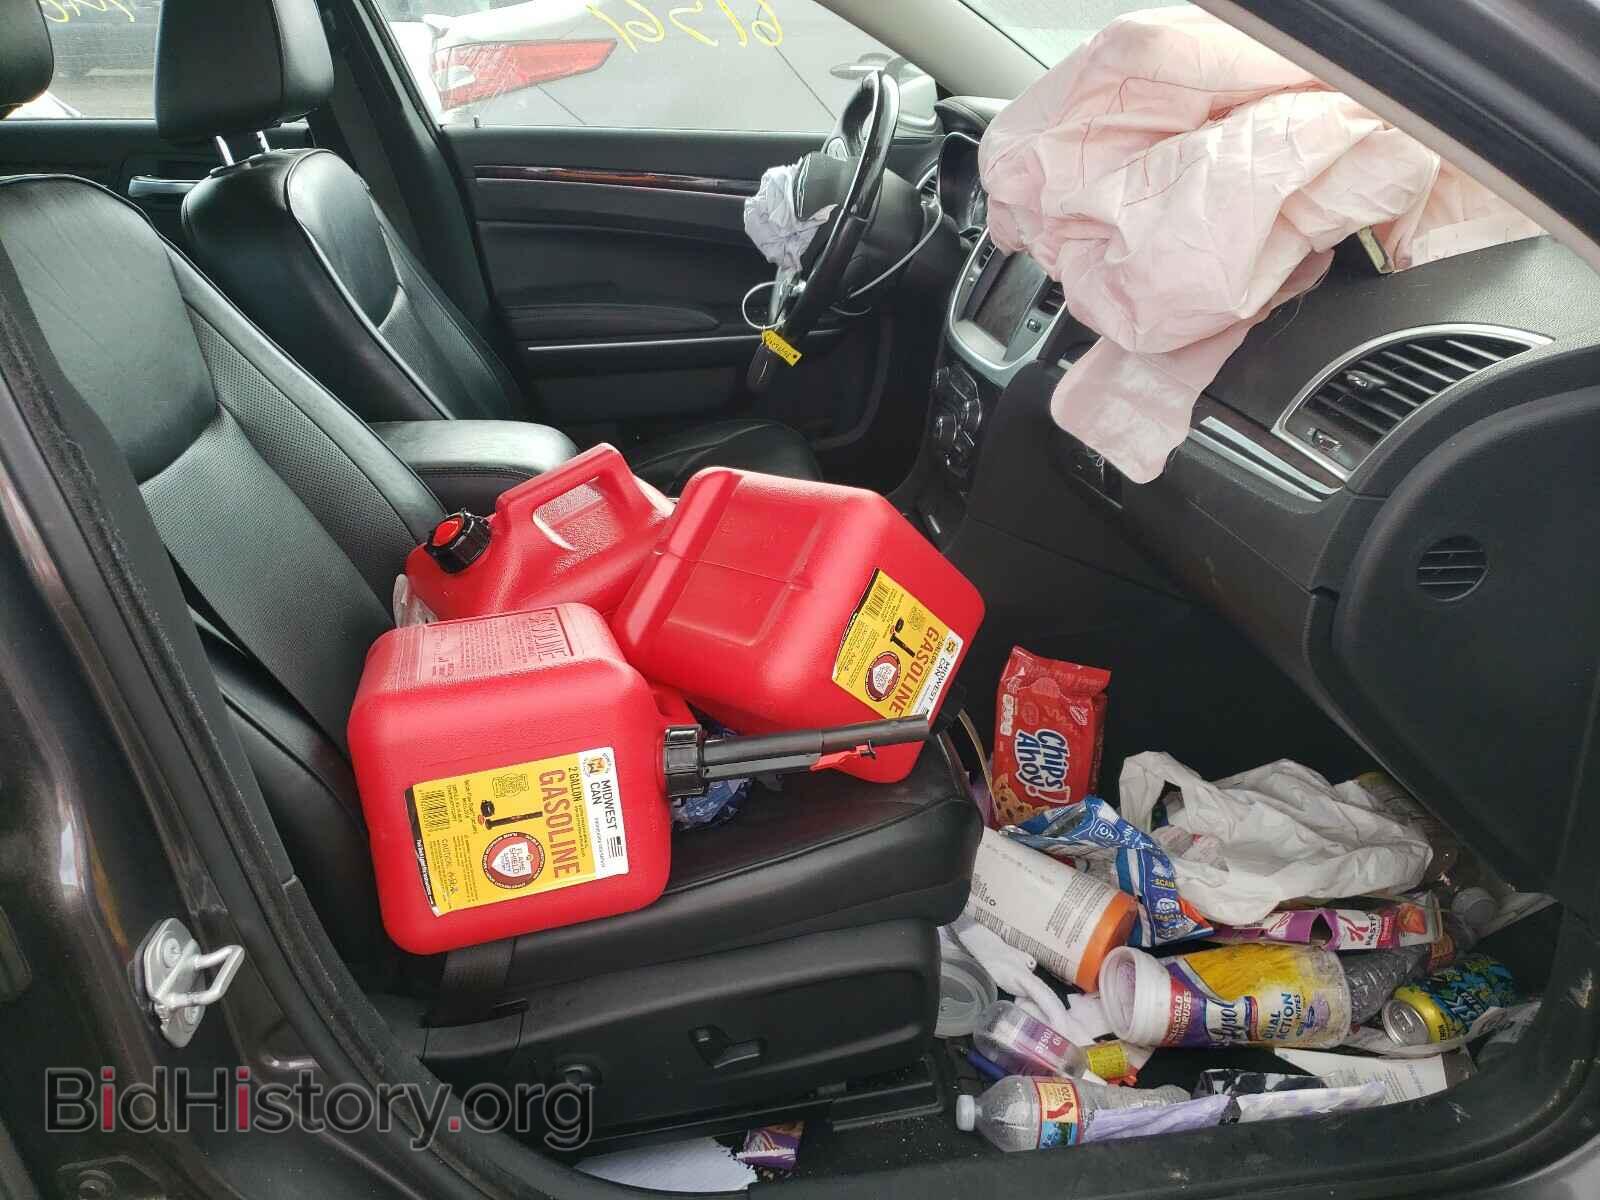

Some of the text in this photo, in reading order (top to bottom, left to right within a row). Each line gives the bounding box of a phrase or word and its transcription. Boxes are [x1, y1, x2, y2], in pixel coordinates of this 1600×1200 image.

[888, 626, 940, 716] GASOLINE
[929, 661, 951, 703] MIDWEST
[935, 657, 946, 677] CAN
[1037, 730, 1068, 790] Chips
[570, 774, 583, 803] GALLON
[590, 782, 603, 806] CAN
[601, 779, 618, 831] MIDWEST
[539, 769, 581, 880] GASOLINE
[1173, 995, 1184, 1022] COLD
[1206, 1002, 1248, 1046] Lysol
[1264, 1010, 1281, 1040] DUAL
[1276, 991, 1295, 1040] ACTION
